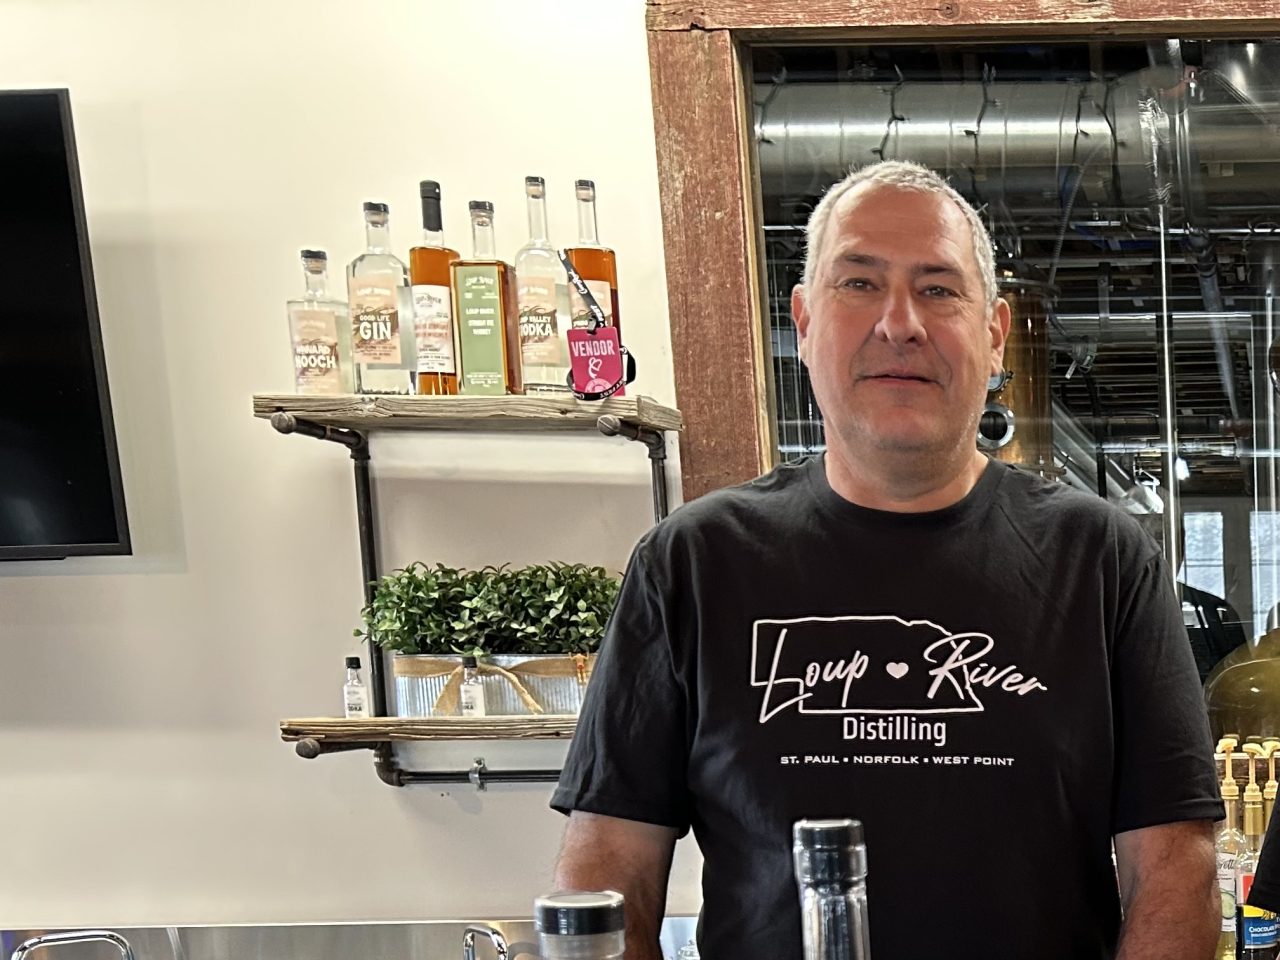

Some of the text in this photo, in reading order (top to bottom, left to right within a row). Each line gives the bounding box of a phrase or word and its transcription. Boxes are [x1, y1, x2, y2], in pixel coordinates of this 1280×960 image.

[359, 322, 392, 340] GIN
[571, 340, 615, 357] VENDOR
[295, 354, 336, 368] HOOCH
[760, 628, 1047, 723] Loup River
[843, 716, 947, 747] Distilling
[780, 756, 1015, 766] ST. PAUL NORFOLK WEST POINT
